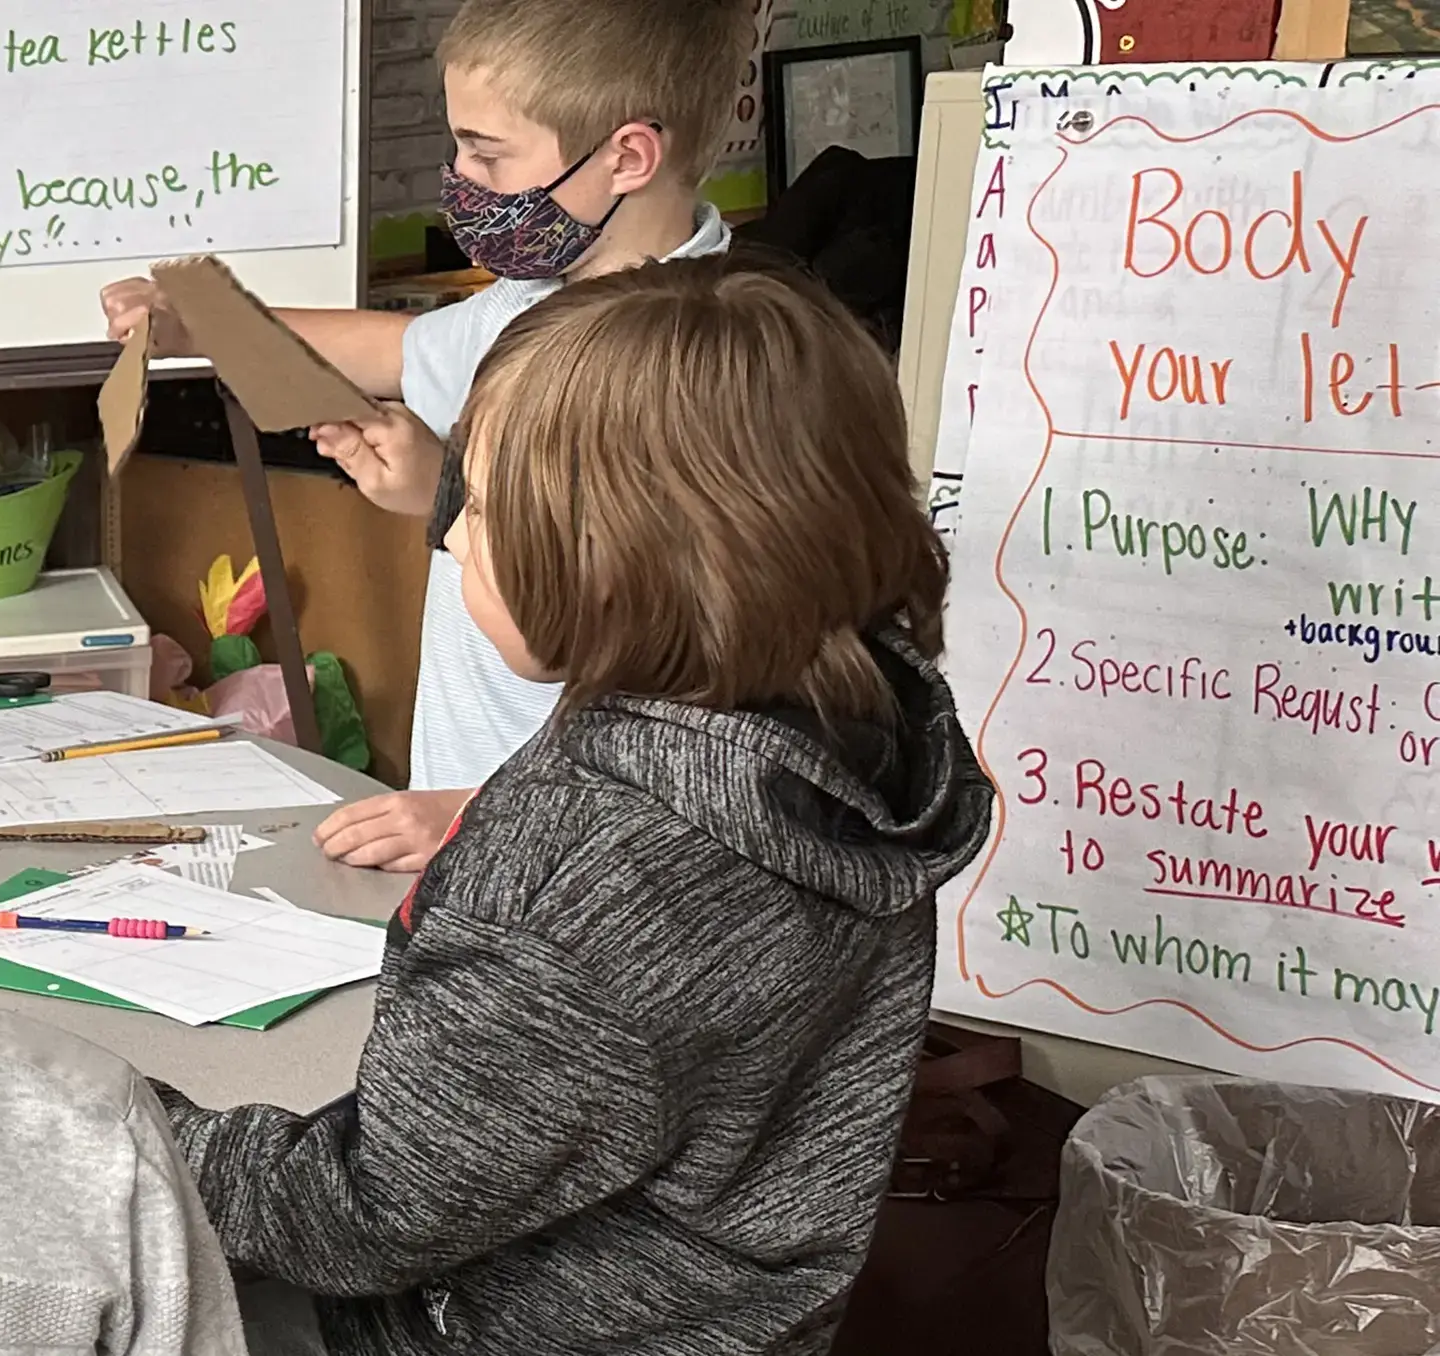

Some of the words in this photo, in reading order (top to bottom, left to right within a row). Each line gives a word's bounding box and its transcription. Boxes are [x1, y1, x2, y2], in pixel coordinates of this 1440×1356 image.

[4, 29, 68, 73] tea
[87, 17, 237, 67] kettles
[16, 165, 204, 211] because,
[205, 150, 281, 195] the
[1123, 167, 1369, 328] Body
[1109, 339, 1235, 421] your
[1301, 332, 1440, 423] let
[1082, 488, 1268, 575] Purpose:
[1308, 486, 1417, 555] WHY
[1071, 640, 1232, 700] Specific
[1284, 612, 1440, 664] +backgrou
[1017, 748, 1060, 807] 3.
[1076, 758, 1269, 839] Restate
[1304, 815, 1400, 871] your
[1060, 829, 1105, 876] to
[1146, 848, 1406, 922] summarize
[1036, 901, 1090, 960] To
[1110, 914, 1252, 983] whom
[1276, 946, 1319, 997] it
[1333, 968, 1440, 1035] may
